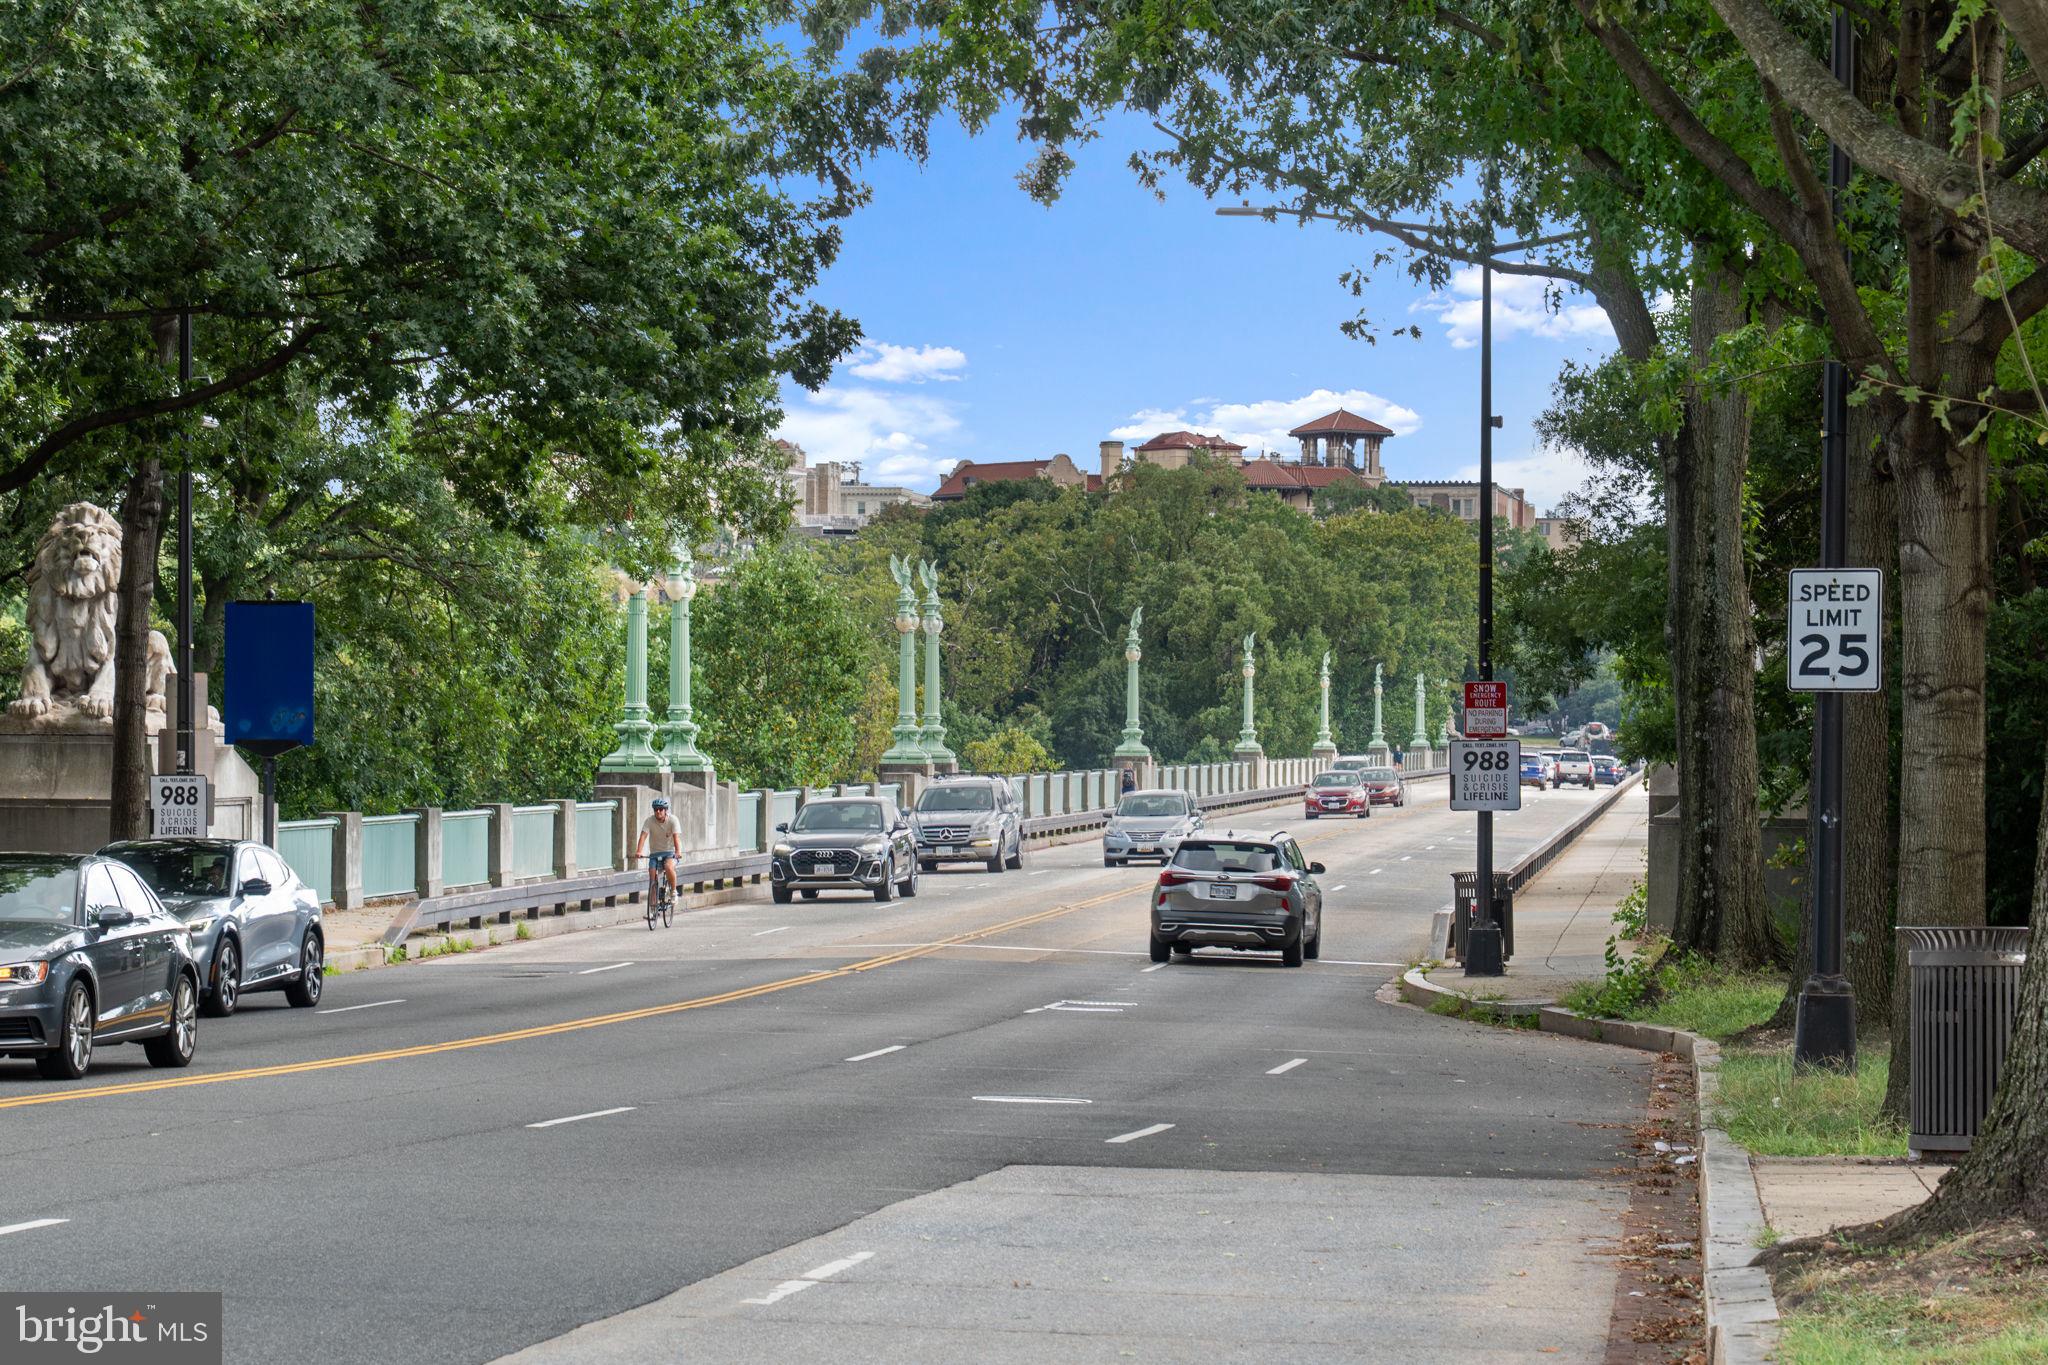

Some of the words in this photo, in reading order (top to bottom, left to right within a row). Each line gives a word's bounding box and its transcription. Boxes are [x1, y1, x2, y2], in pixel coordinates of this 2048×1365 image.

[1800, 584, 1870, 602] SPEED
[1807, 609, 1862, 627] LIMIT
[1799, 634, 1869, 677] 25
[1473, 684, 1497, 693] SNOW
[1474, 698, 1497, 707] ROUTE
[1463, 751, 1509, 771] 988
[1463, 774, 1509, 782] SUICIDE
[1463, 782, 1469, 791] &
[1472, 782, 1509, 791] CRISIS
[161, 786, 198, 805] 988
[1464, 792, 1509, 801] LIFELINE
[160, 808, 197, 816] SUICIDE
[168, 817, 198, 826] CRISIS
[160, 826, 197, 835] LIFELINE
